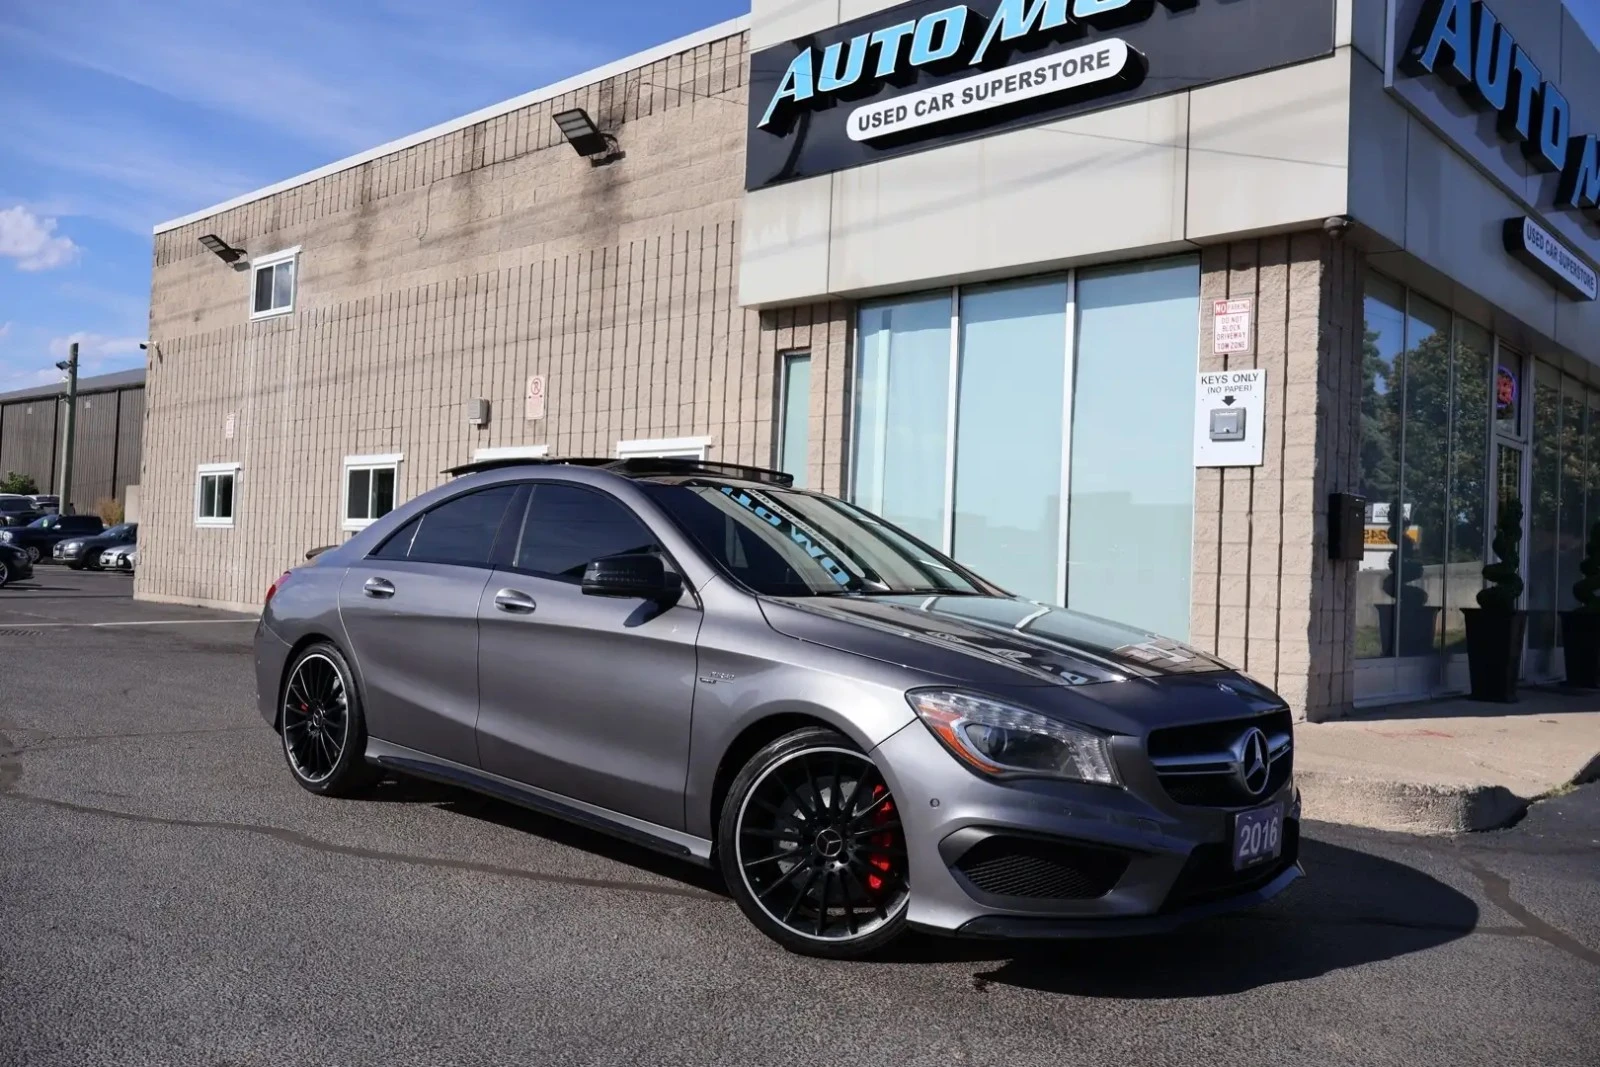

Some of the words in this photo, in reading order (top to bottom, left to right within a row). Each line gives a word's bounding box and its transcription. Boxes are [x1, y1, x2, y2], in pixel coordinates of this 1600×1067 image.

[757, 4, 967, 128] AUTO
[969, 0, 1127, 65] M
[858, 104, 908, 132] USED
[914, 92, 954, 117] CAR
[961, 49, 1110, 105] SUPERSTORE
[1418, 0, 1570, 172] AUTO
[1526, 223, 1545, 250] USED
[1545, 239, 1559, 260] CAR
[1558, 250, 1594, 292] SUPERSTORE
[1216, 303, 1227, 314] NO
[1216, 332, 1246, 341] DRIVEWAY
[1201, 374, 1229, 385] KEYS
[1232, 372, 1259, 383] ONLY
[1207, 386, 1222, 395] (NO
[1224, 384, 1253, 393] PAPER)
[1239, 816, 1278, 857] 2016
